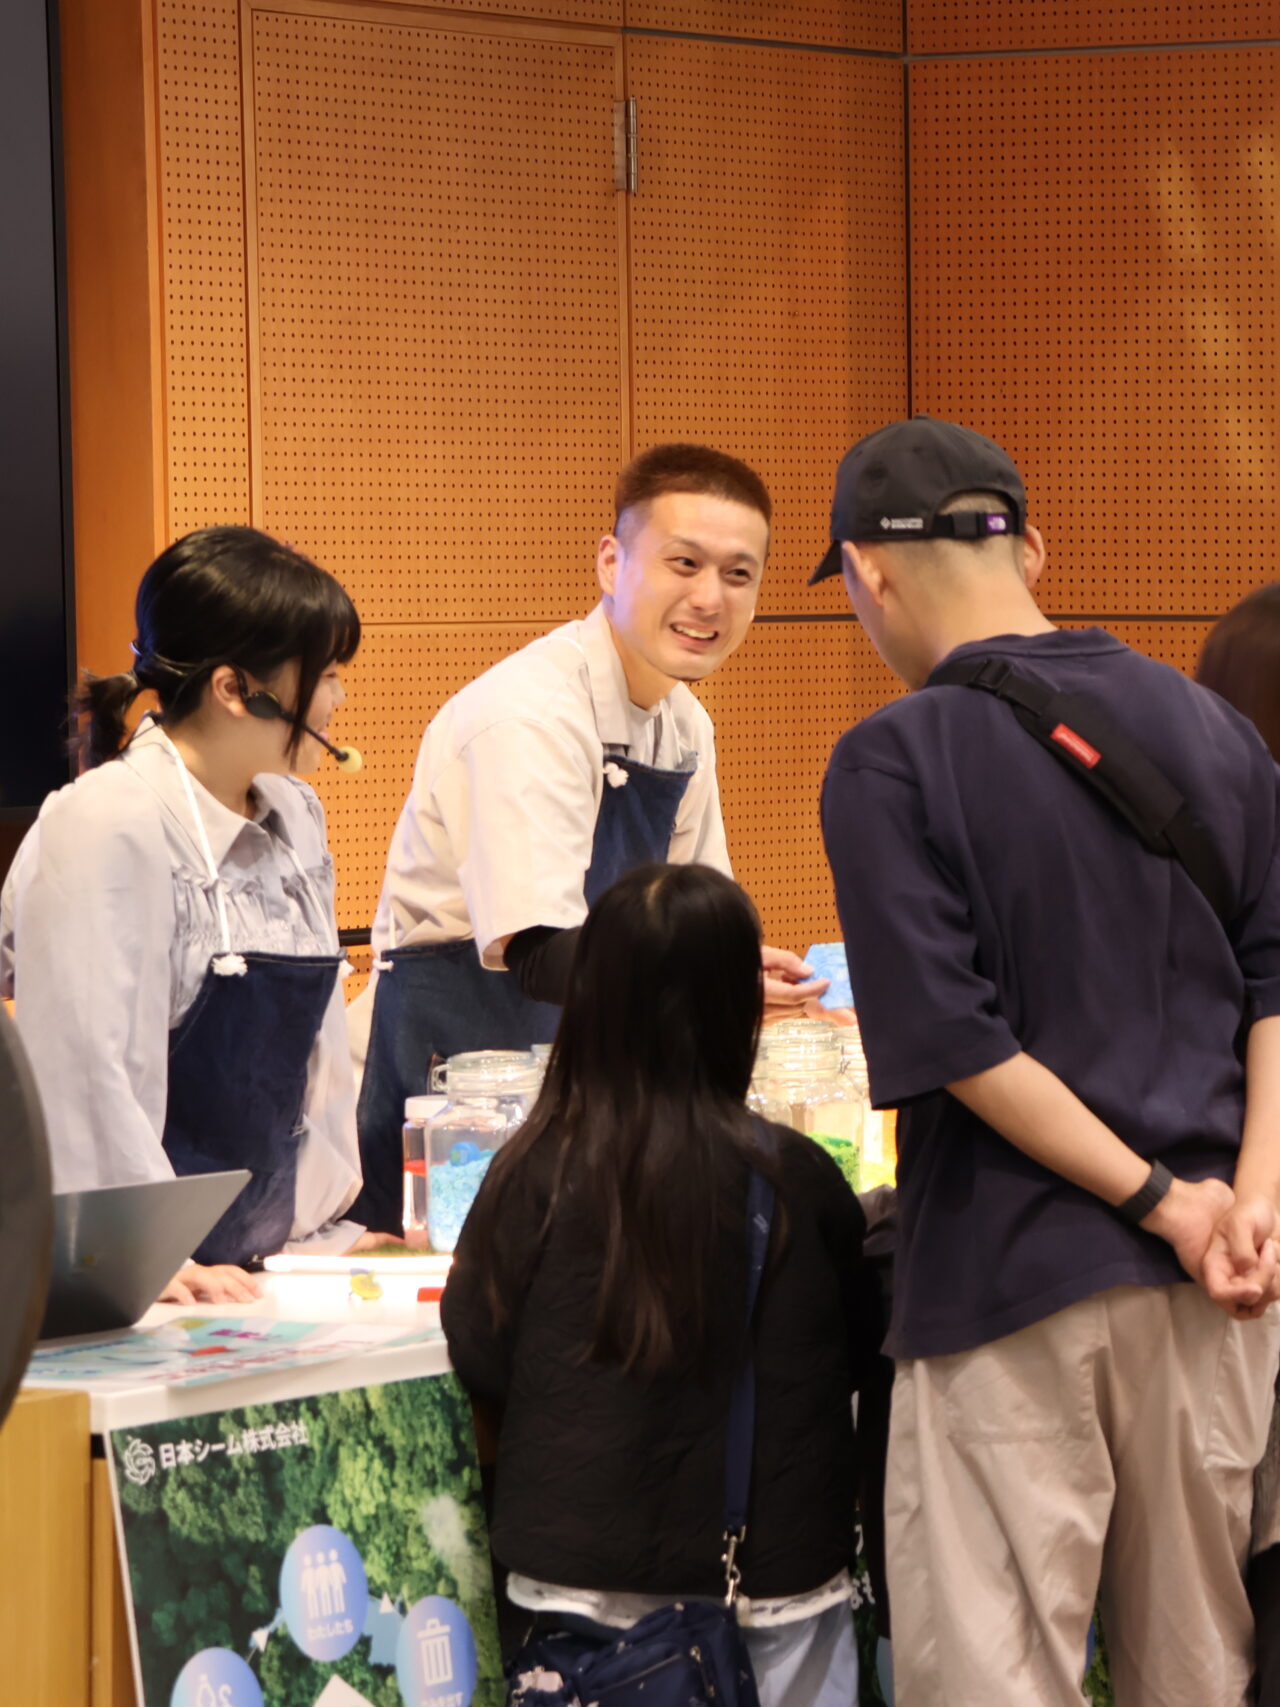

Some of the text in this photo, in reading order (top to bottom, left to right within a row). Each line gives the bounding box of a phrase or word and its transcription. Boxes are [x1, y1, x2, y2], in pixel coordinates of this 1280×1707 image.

[159, 1418, 310, 1469] 日本シーム株式会社
